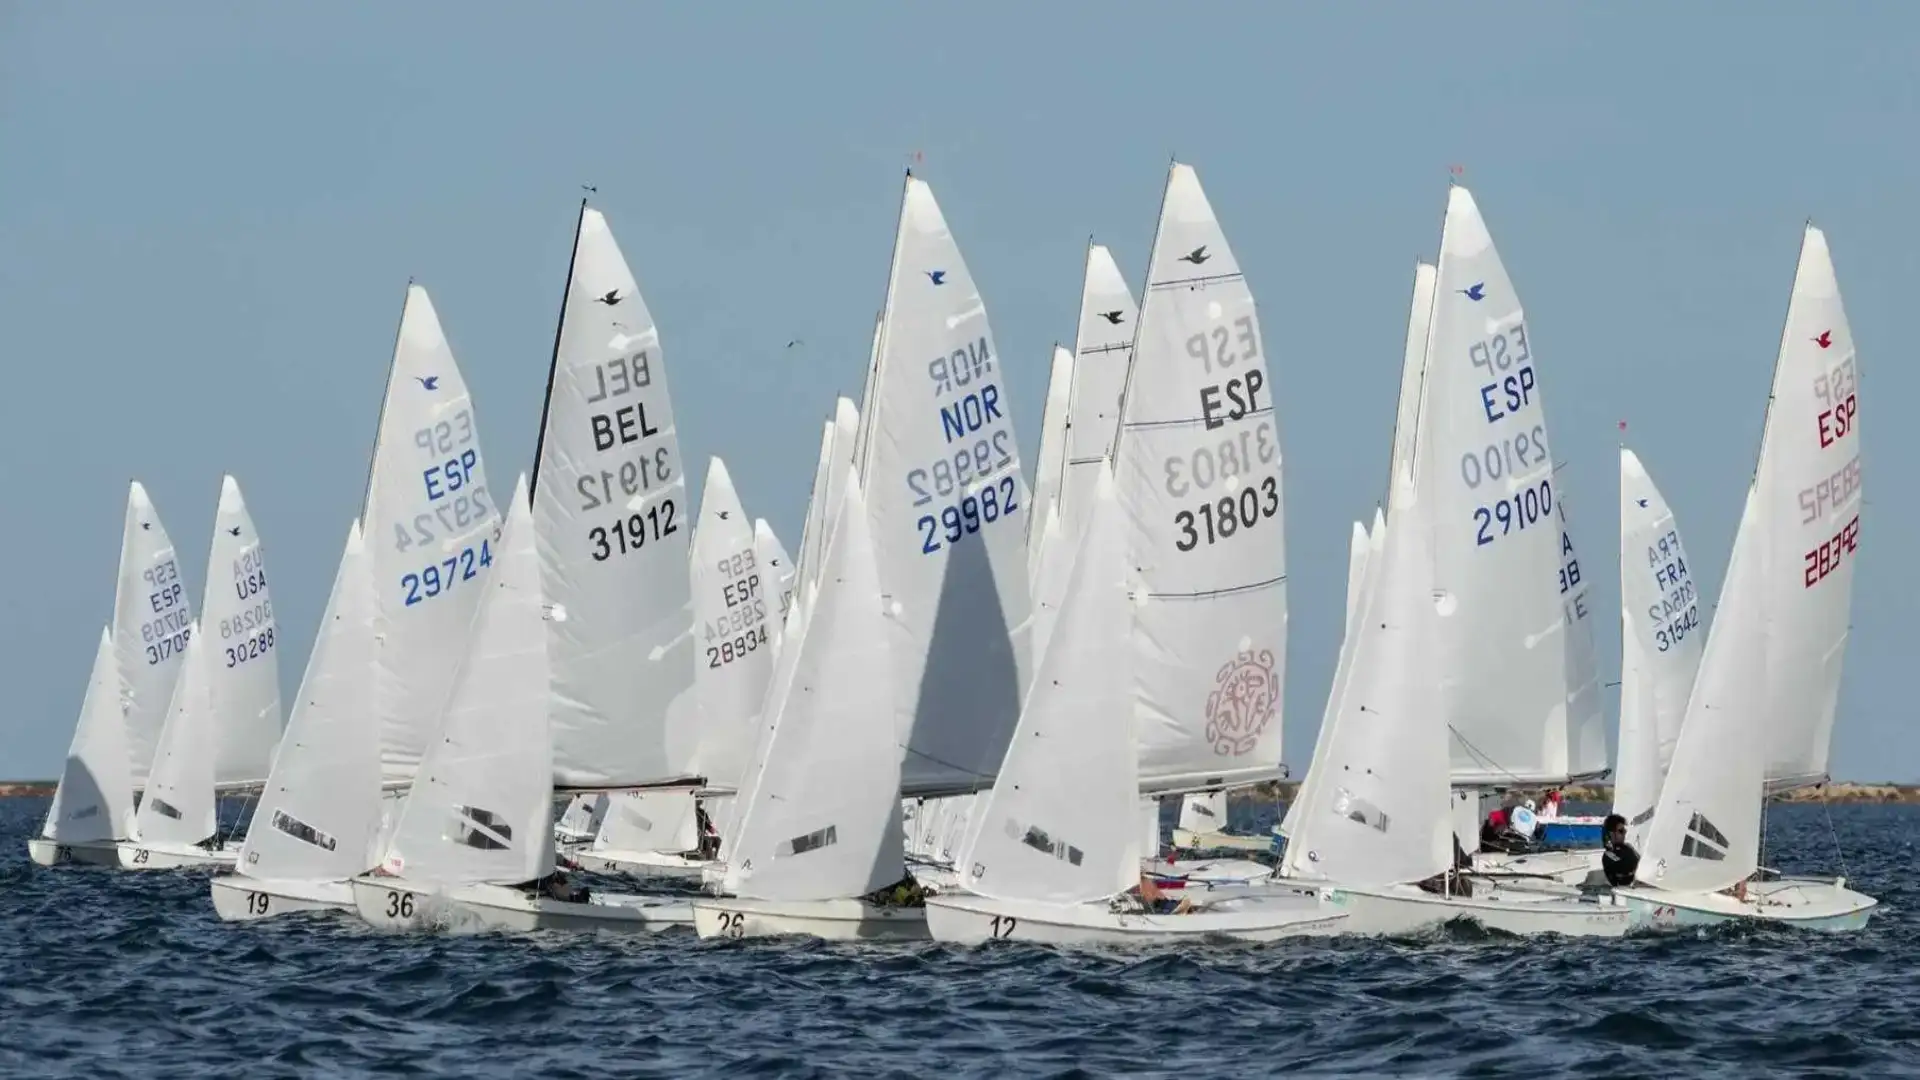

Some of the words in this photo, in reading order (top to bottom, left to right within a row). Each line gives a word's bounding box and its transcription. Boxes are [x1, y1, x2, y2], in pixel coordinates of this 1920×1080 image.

[940, 384, 1002, 444] NOR
[1200, 369, 1263, 430] ESP
[1481, 366, 1534, 423] ESP
[591, 402, 657, 451] BEL
[1818, 394, 1857, 449] ESP
[424, 448, 476, 500] ESP
[588, 499, 677, 562] 31912
[917, 476, 1018, 555] 29982
[1174, 476, 1279, 552] 31803
[1473, 480, 1551, 546] 29100
[401, 539, 492, 606] 29724
[1656, 556, 1687, 592] FRA
[1805, 515, 1859, 588] 28392
[150, 583, 181, 613] ESP
[236, 570, 266, 600] USA
[722, 574, 759, 608] ESP
[226, 628, 274, 668] 30288
[706, 624, 768, 670] 28934
[1656, 605, 1698, 652] 31542
[133, 849, 148, 864] 29
[247, 891, 270, 915] 19
[386, 891, 414, 918] 36
[990, 916, 1017, 938] 12
